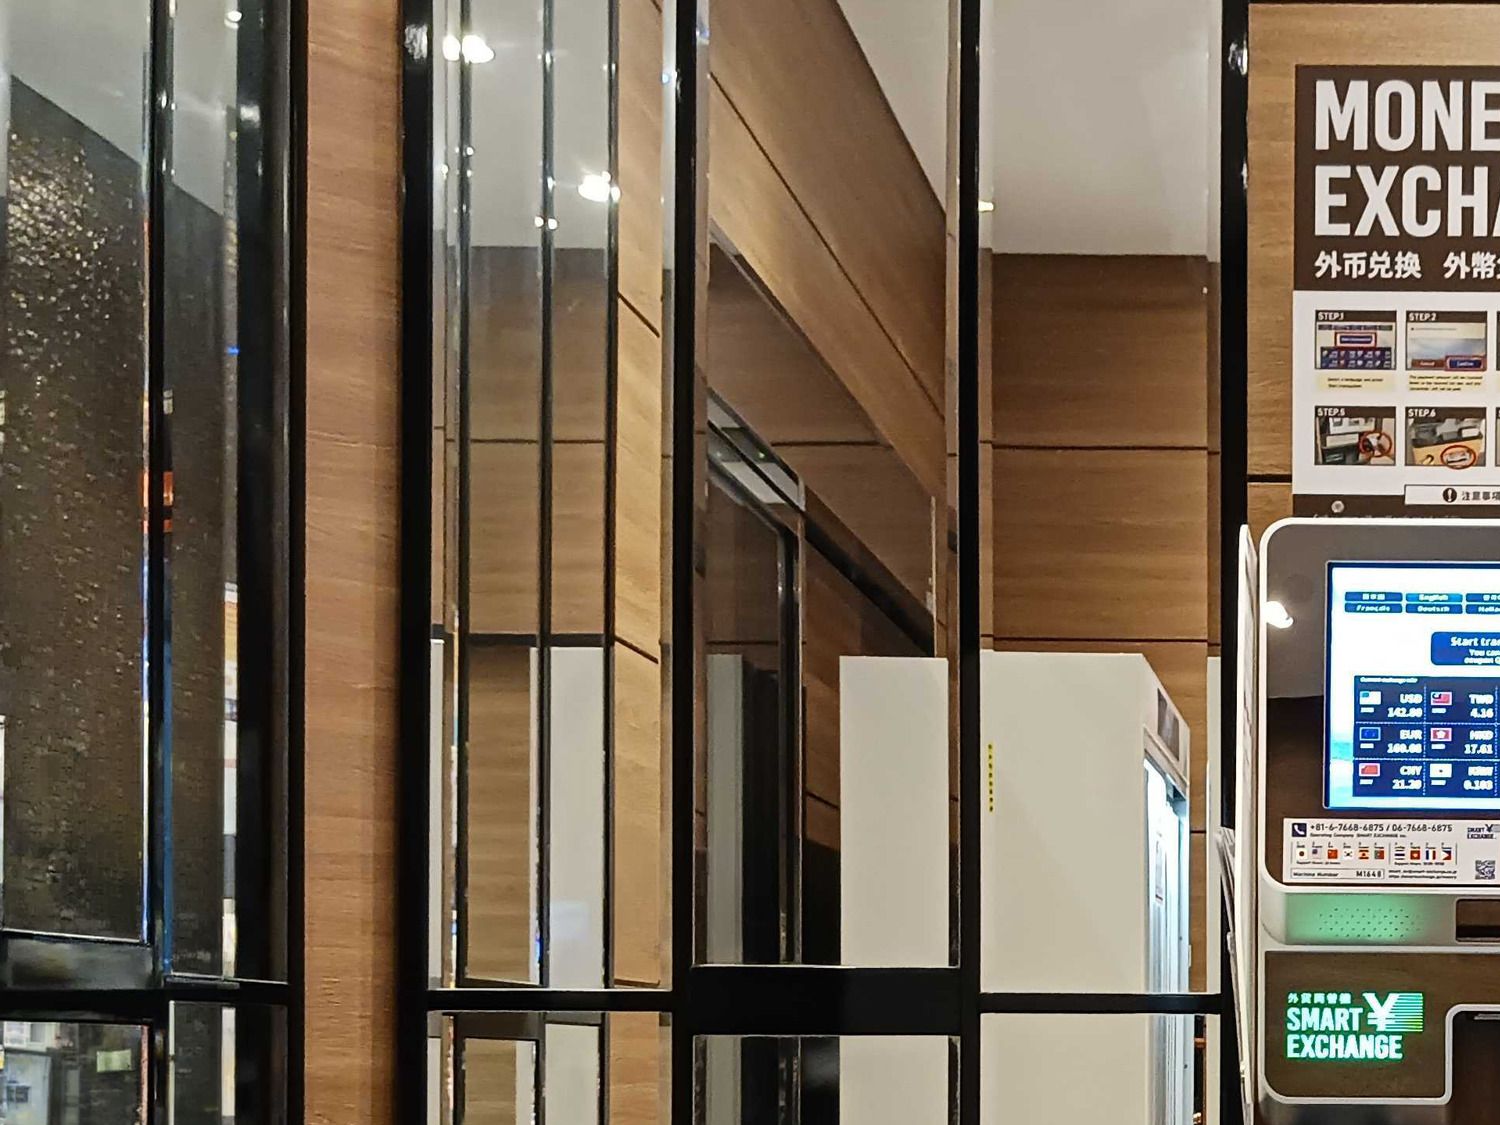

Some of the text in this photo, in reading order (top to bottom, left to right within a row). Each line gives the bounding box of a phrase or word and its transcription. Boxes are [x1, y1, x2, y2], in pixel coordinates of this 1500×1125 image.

[1314, 251, 1422, 280] 外币兑换
[1318, 312, 1344, 320] STEP.1
[1408, 312, 1436, 321] STEP.2
[1317, 408, 1346, 416] STEP.5
[1408, 408, 1436, 417] STEP.6
[1450, 636, 1478, 646] Start
[1400, 694, 1422, 704] USD
[1400, 730, 1422, 740] EUR
[1400, 766, 1422, 775] CNY
[1392, 824, 1452, 832] 06-7668-6875
[1287, 1007, 1364, 1031] SMART
[1287, 1034, 1403, 1059] EXCHANGE
